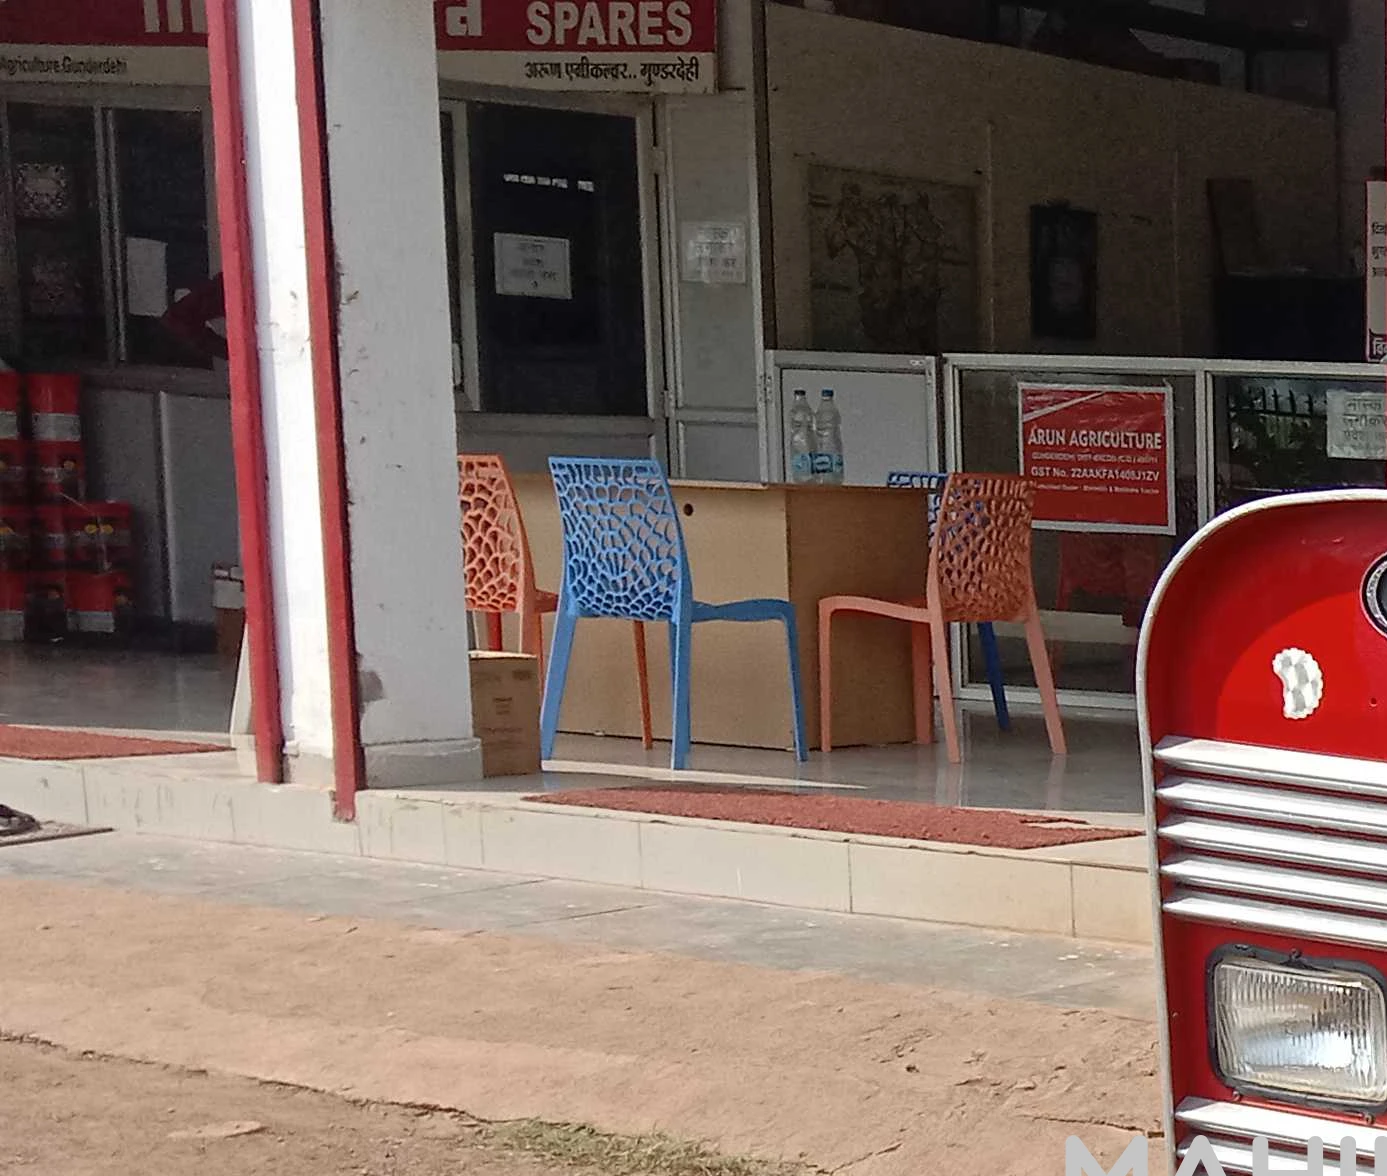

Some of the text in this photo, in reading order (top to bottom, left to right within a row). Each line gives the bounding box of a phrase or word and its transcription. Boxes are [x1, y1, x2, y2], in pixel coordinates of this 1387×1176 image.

[526, 1, 692, 46] SPARES
[1028, 427, 1162, 450] ARUN AGRICULTURE
[1031, 466, 1050, 478] GST
